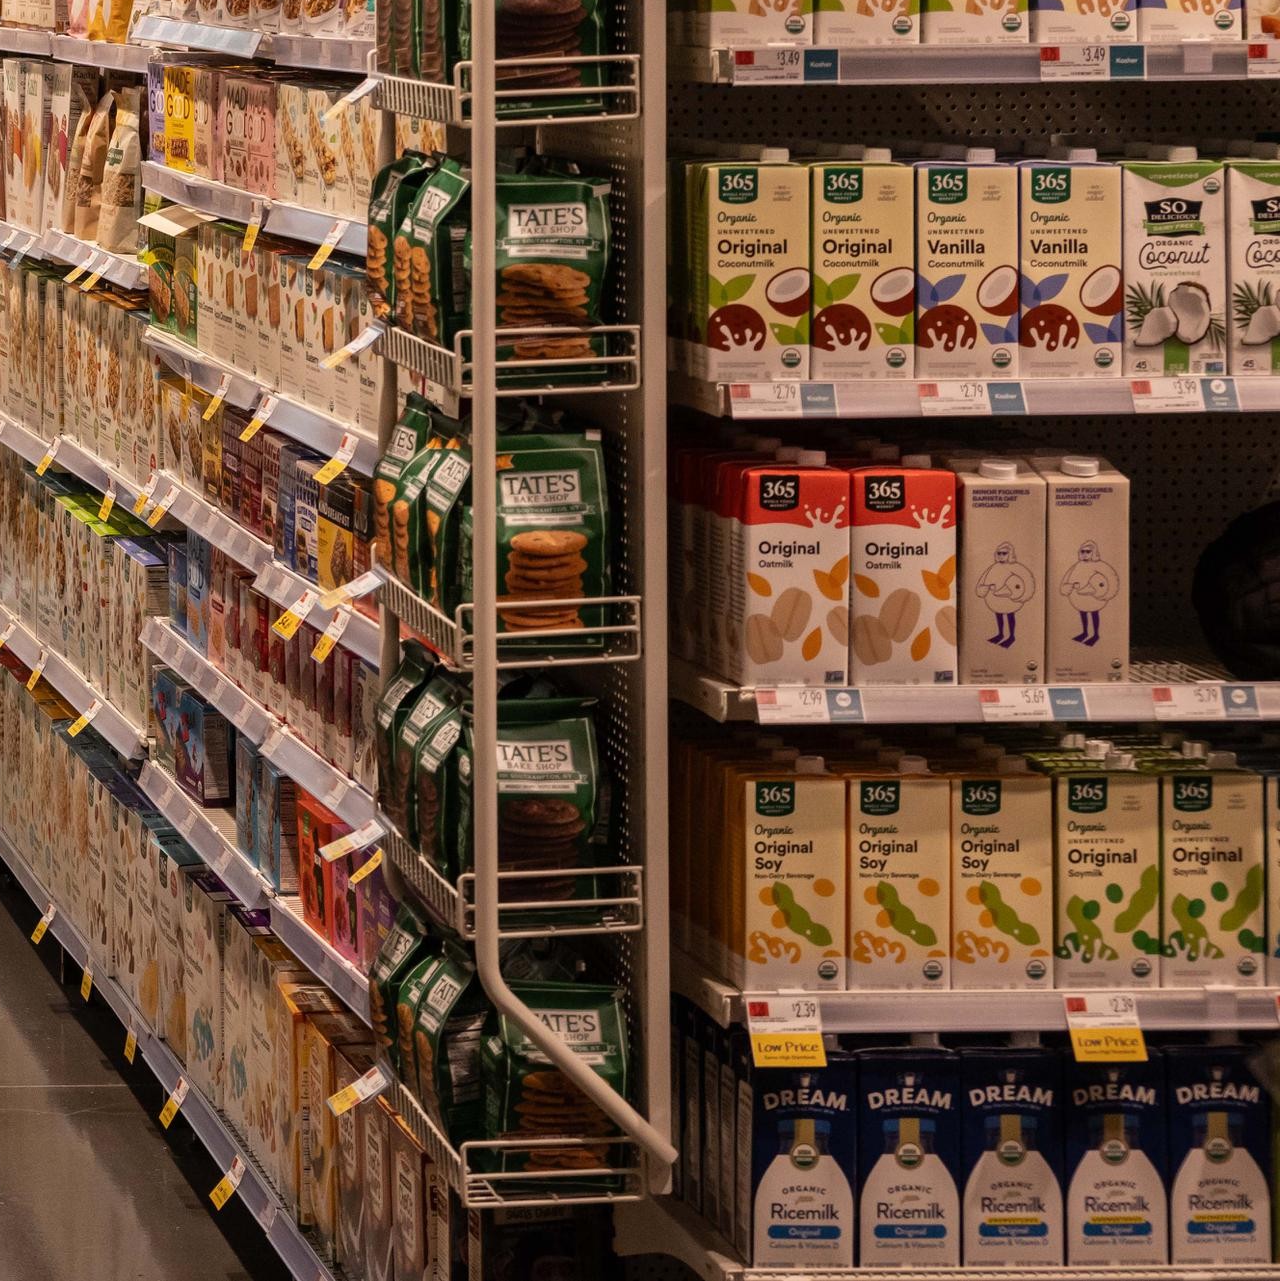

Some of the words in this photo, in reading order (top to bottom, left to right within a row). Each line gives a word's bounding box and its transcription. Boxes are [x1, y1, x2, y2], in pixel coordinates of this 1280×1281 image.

[777, 52, 800, 66] $3.49
[1083, 47, 1105, 61] $3.49
[166, 69, 190, 95] MADE
[167, 95, 190, 119] GOOD
[722, 174, 754, 191] 365
[932, 174, 963, 191] 365
[1035, 174, 1067, 190] 365
[1160, 201, 1186, 214] SO
[513, 208, 583, 226] TATE'S
[718, 212, 757, 225] Organic
[823, 212, 862, 225] Organic
[718, 239, 788, 257] Original
[823, 239, 892, 257] Original
[928, 240, 985, 254] Vanilla
[1031, 239, 1088, 254] Vanilla
[718, 259, 774, 268] Coconutmilk
[823, 259, 879, 267] Coconutmilk
[1030, 259, 1087, 268] Coconutmilk
[1139, 242, 1211, 270] Coconut
[774, 385, 796, 399] $2.79
[505, 474, 576, 494] TATE'S
[763, 481, 795, 498] 365
[869, 482, 900, 499] 365
[514, 495, 538, 503] BAKE
[544, 494, 569, 502] SHOP
[759, 541, 820, 557] Original
[865, 542, 928, 558] Original
[759, 560, 793, 568] Oatmilk
[866, 561, 902, 569] Oatmilk
[498, 744, 567, 762] TATE'S
[536, 762, 562, 770] SHOP
[759, 786, 790, 804] 365
[864, 786, 895, 803] 365
[1177, 783, 1208, 799] 365
[755, 824, 793, 837] Organic
[860, 823, 898, 836] Organic
[961, 823, 999, 836] Organic
[755, 841, 813, 856] Original
[860, 840, 917, 855] Original
[961, 839, 1019, 854] Original
[962, 856, 988, 871] Soy
[1068, 849, 1137, 866] Original
[1173, 847, 1242, 865] Original
[755, 857, 782, 872] Soy
[860, 857, 886, 871] Soy
[1068, 869, 1103, 879] Soymilk
[792, 1002, 816, 1018] $2.39
[758, 1043, 782, 1053] Low
[786, 1042, 819, 1053] Price
[1078, 1037, 1102, 1047] Low
[1105, 1036, 1138, 1047] Price
[763, 1088, 847, 1111] DREAM
[867, 1088, 952, 1110] DREAM
[969, 1085, 1053, 1106] DREAM
[1176, 1083, 1260, 1104] DREAM
[782, 1186, 826, 1195] ORGANIC
[771, 1203, 839, 1220] Ricemilk
[877, 1203, 944, 1219] Ricemilk
[981, 1197, 1045, 1213] Ricemilk
